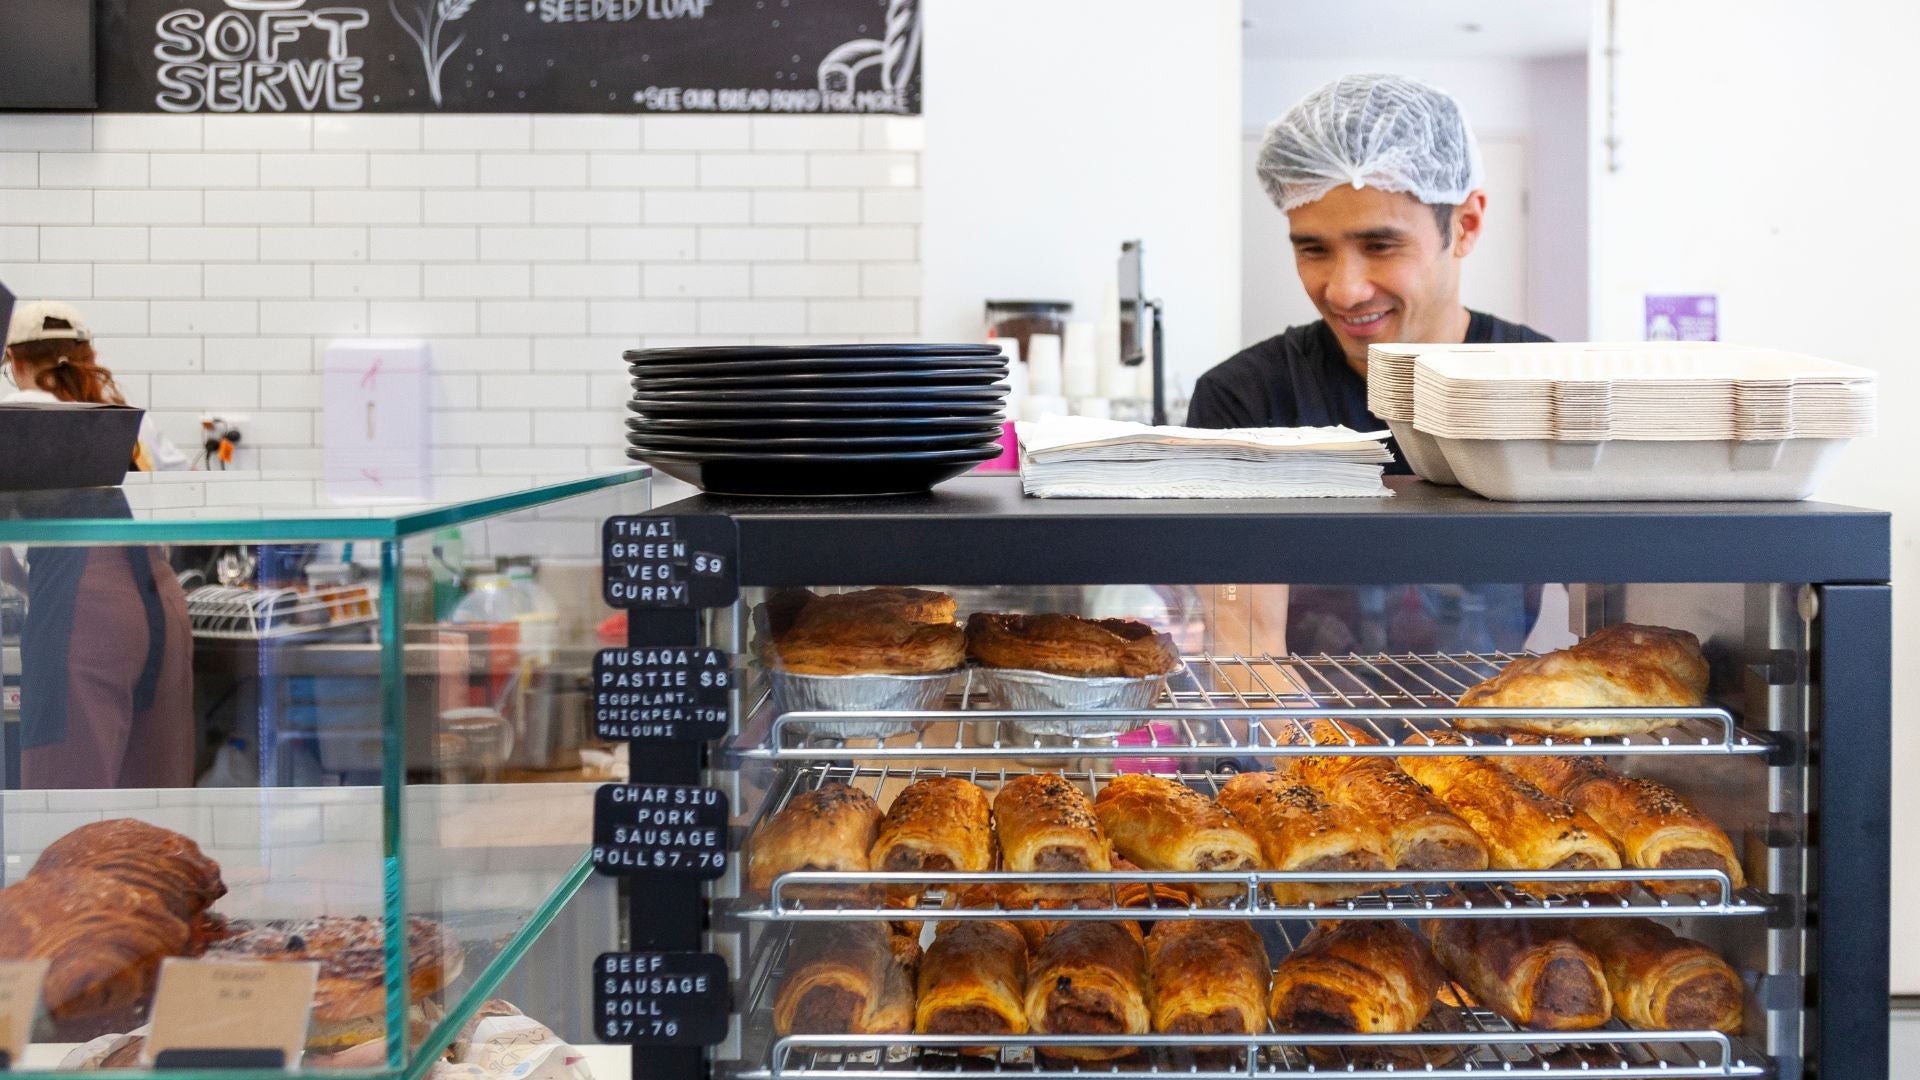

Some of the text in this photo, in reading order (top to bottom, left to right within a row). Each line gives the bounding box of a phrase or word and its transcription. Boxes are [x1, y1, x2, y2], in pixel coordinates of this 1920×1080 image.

[539, 0, 643, 23] SEEDED
[154, 8, 369, 64] SOFT
[155, 57, 364, 112] SERVE
[615, 521, 671, 537] THAI
[612, 543, 685, 558] GREEN
[627, 564, 670, 580] VEG
[695, 556, 722, 573] $9
[611, 583, 683, 600] CURRY
[602, 671, 728, 687] PASTIE $8
[599, 723, 673, 737] HALOUMI
[613, 787, 717, 805] CHAR SIU
[638, 809, 696, 825] PORK
[615, 828, 716, 846] SAUSAGE
[592, 847, 725, 867] ROLL $7.70
[606, 957, 662, 973] BEEF
[605, 976, 706, 994] SAUSAGE
[605, 1001, 662, 1016] ROLL
[606, 1020, 678, 1036] $7.70
